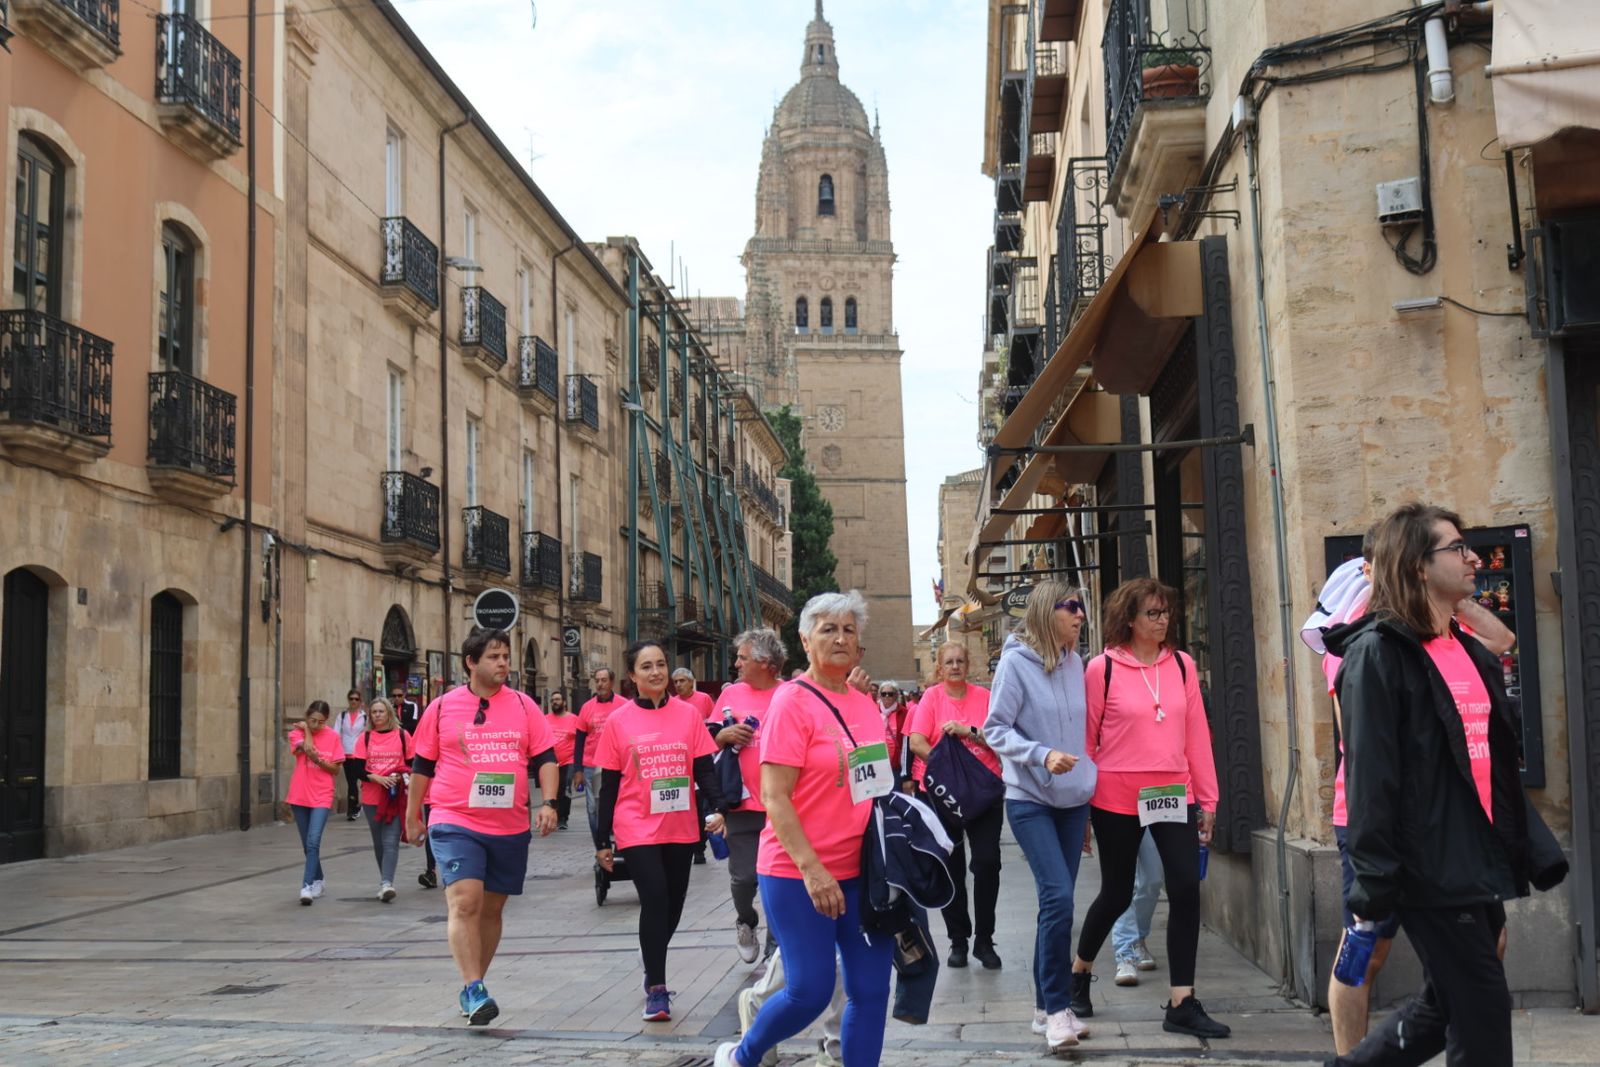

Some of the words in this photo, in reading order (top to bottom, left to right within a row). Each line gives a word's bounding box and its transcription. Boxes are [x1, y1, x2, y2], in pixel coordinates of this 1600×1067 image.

[464, 731, 479, 740] En
[481, 730, 521, 740] marcha
[467, 741, 507, 751] contra
[637, 744, 650, 754] En
[652, 742, 688, 751] marcha
[471, 751, 519, 763] cáncer
[639, 751, 677, 766] contra
[641, 764, 687, 779] cáncer
[478, 784, 506, 797] 5995
[659, 788, 680, 801] 5997
[1145, 797, 1179, 811] 10263
